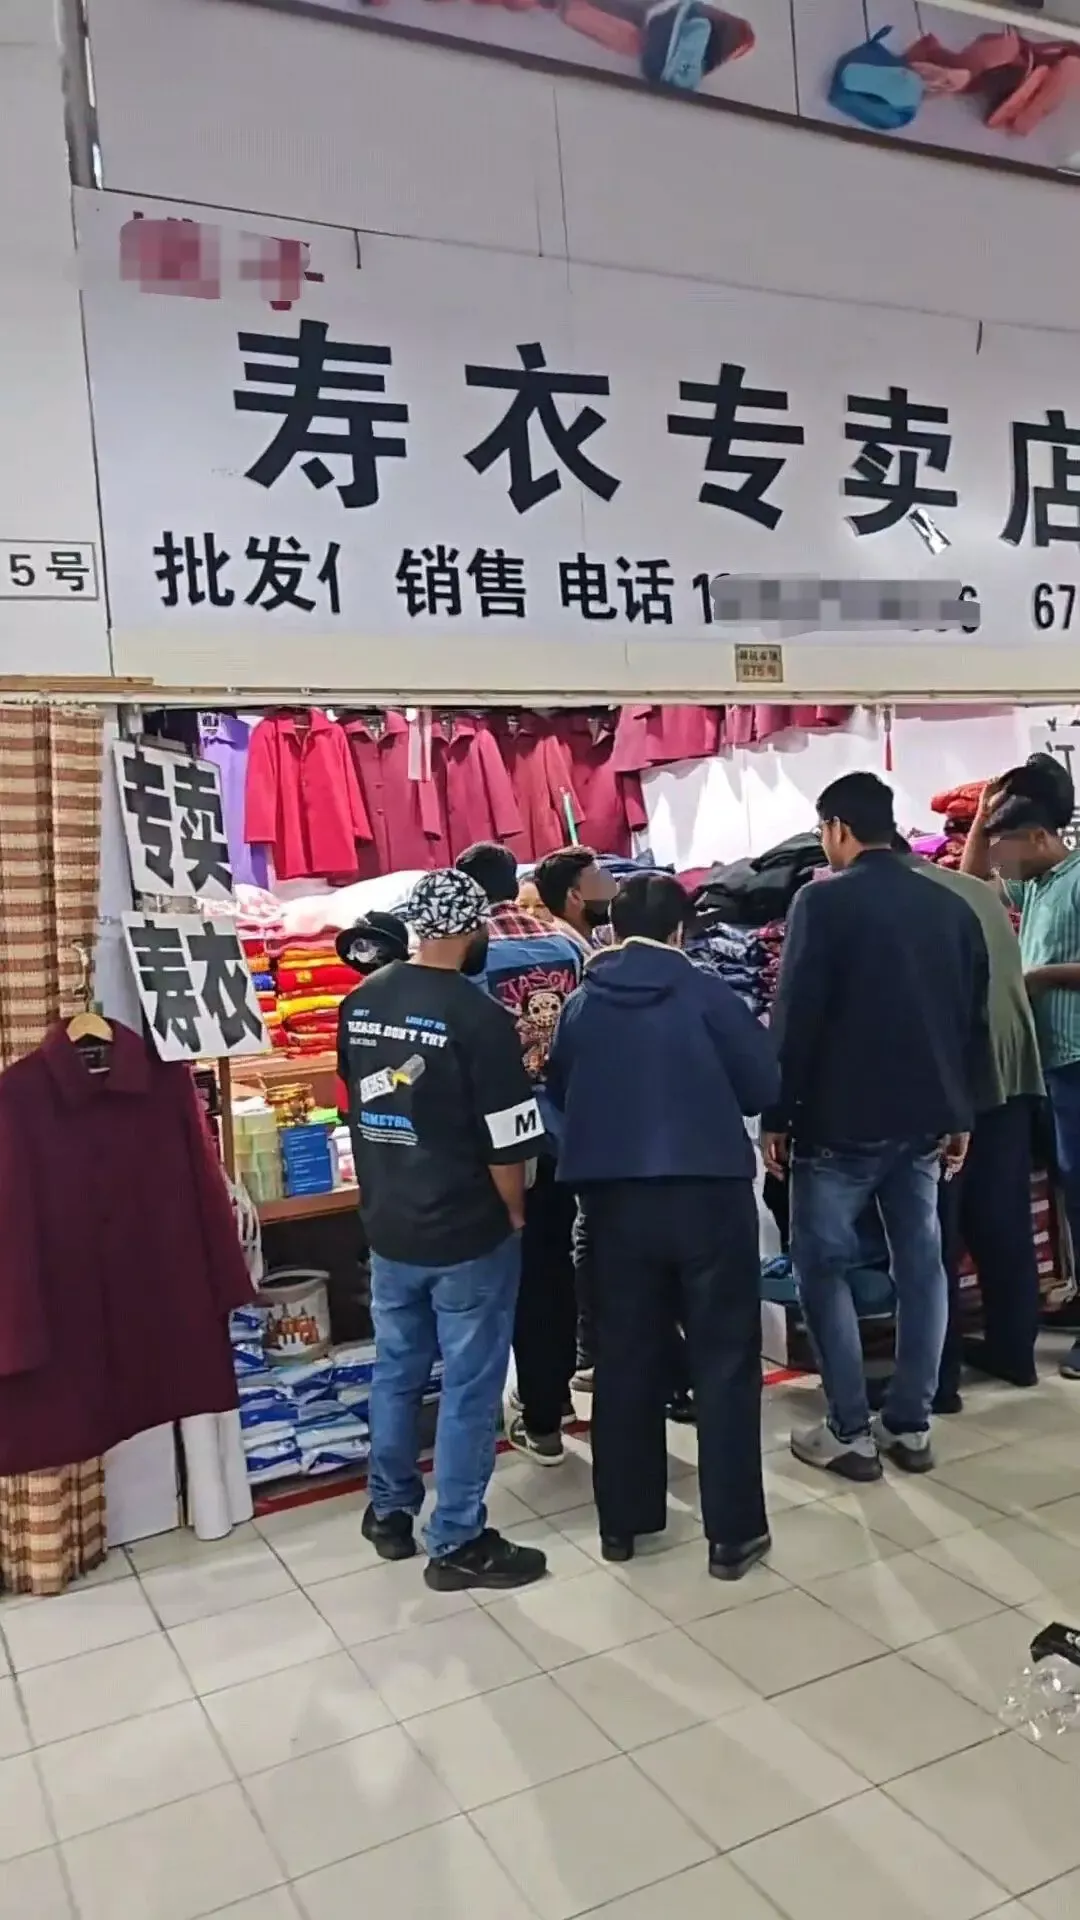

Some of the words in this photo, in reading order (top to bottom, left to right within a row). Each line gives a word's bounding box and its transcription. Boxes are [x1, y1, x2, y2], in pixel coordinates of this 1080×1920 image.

[233, 318, 1080, 553] 寿衣专卖店
[9, 551, 90, 592] 5号
[396, 544, 526, 618] 销售
[559, 552, 674, 625] 电话
[123, 751, 234, 895] 专卖
[128, 919, 263, 1053] 寿衣
[420, 1031, 448, 1048] TRY
[515, 1109, 536, 1137] M
